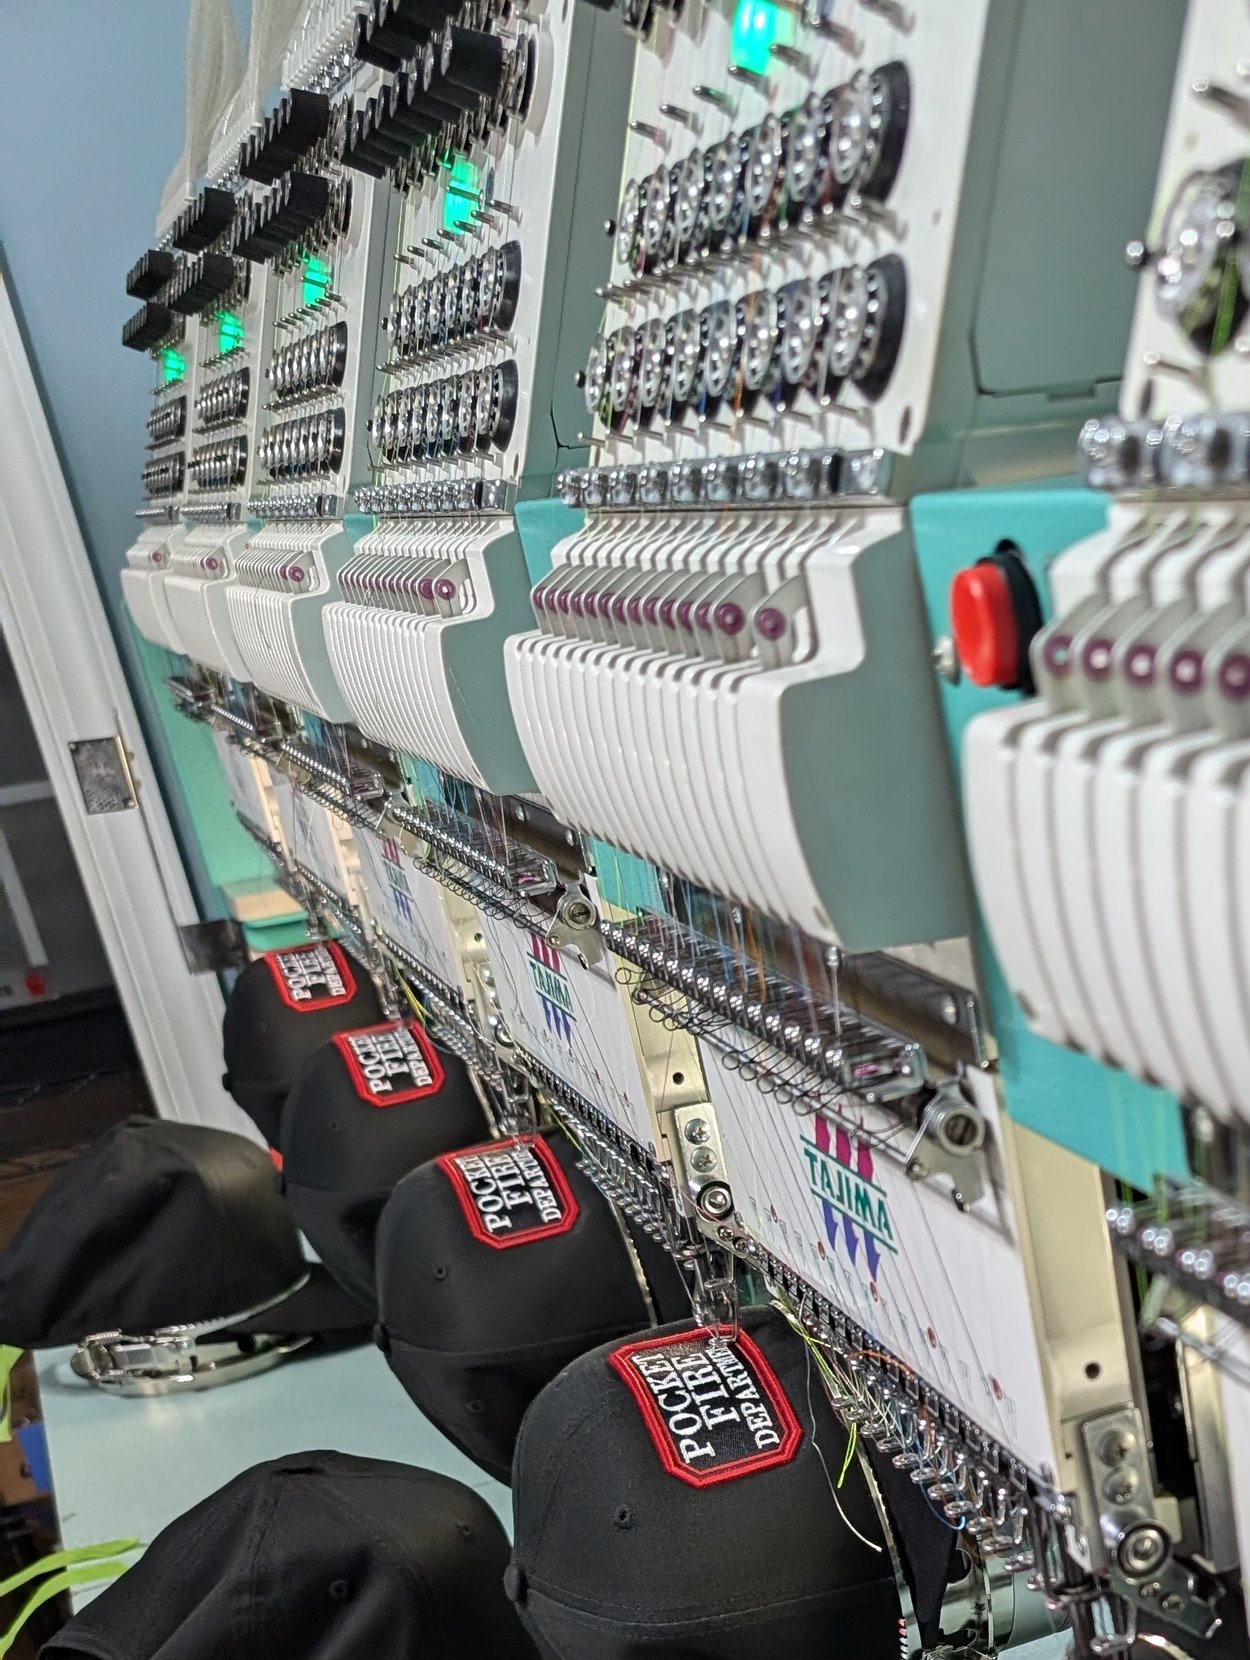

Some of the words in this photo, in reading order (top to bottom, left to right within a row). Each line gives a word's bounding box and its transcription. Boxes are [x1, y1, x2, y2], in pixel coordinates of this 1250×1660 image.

[481, 1154, 533, 1210] FIRE
[803, 1147, 894, 1242] TAJIMA
[631, 1353, 716, 1464] POCKET
[671, 1352, 741, 1431] FIRE
